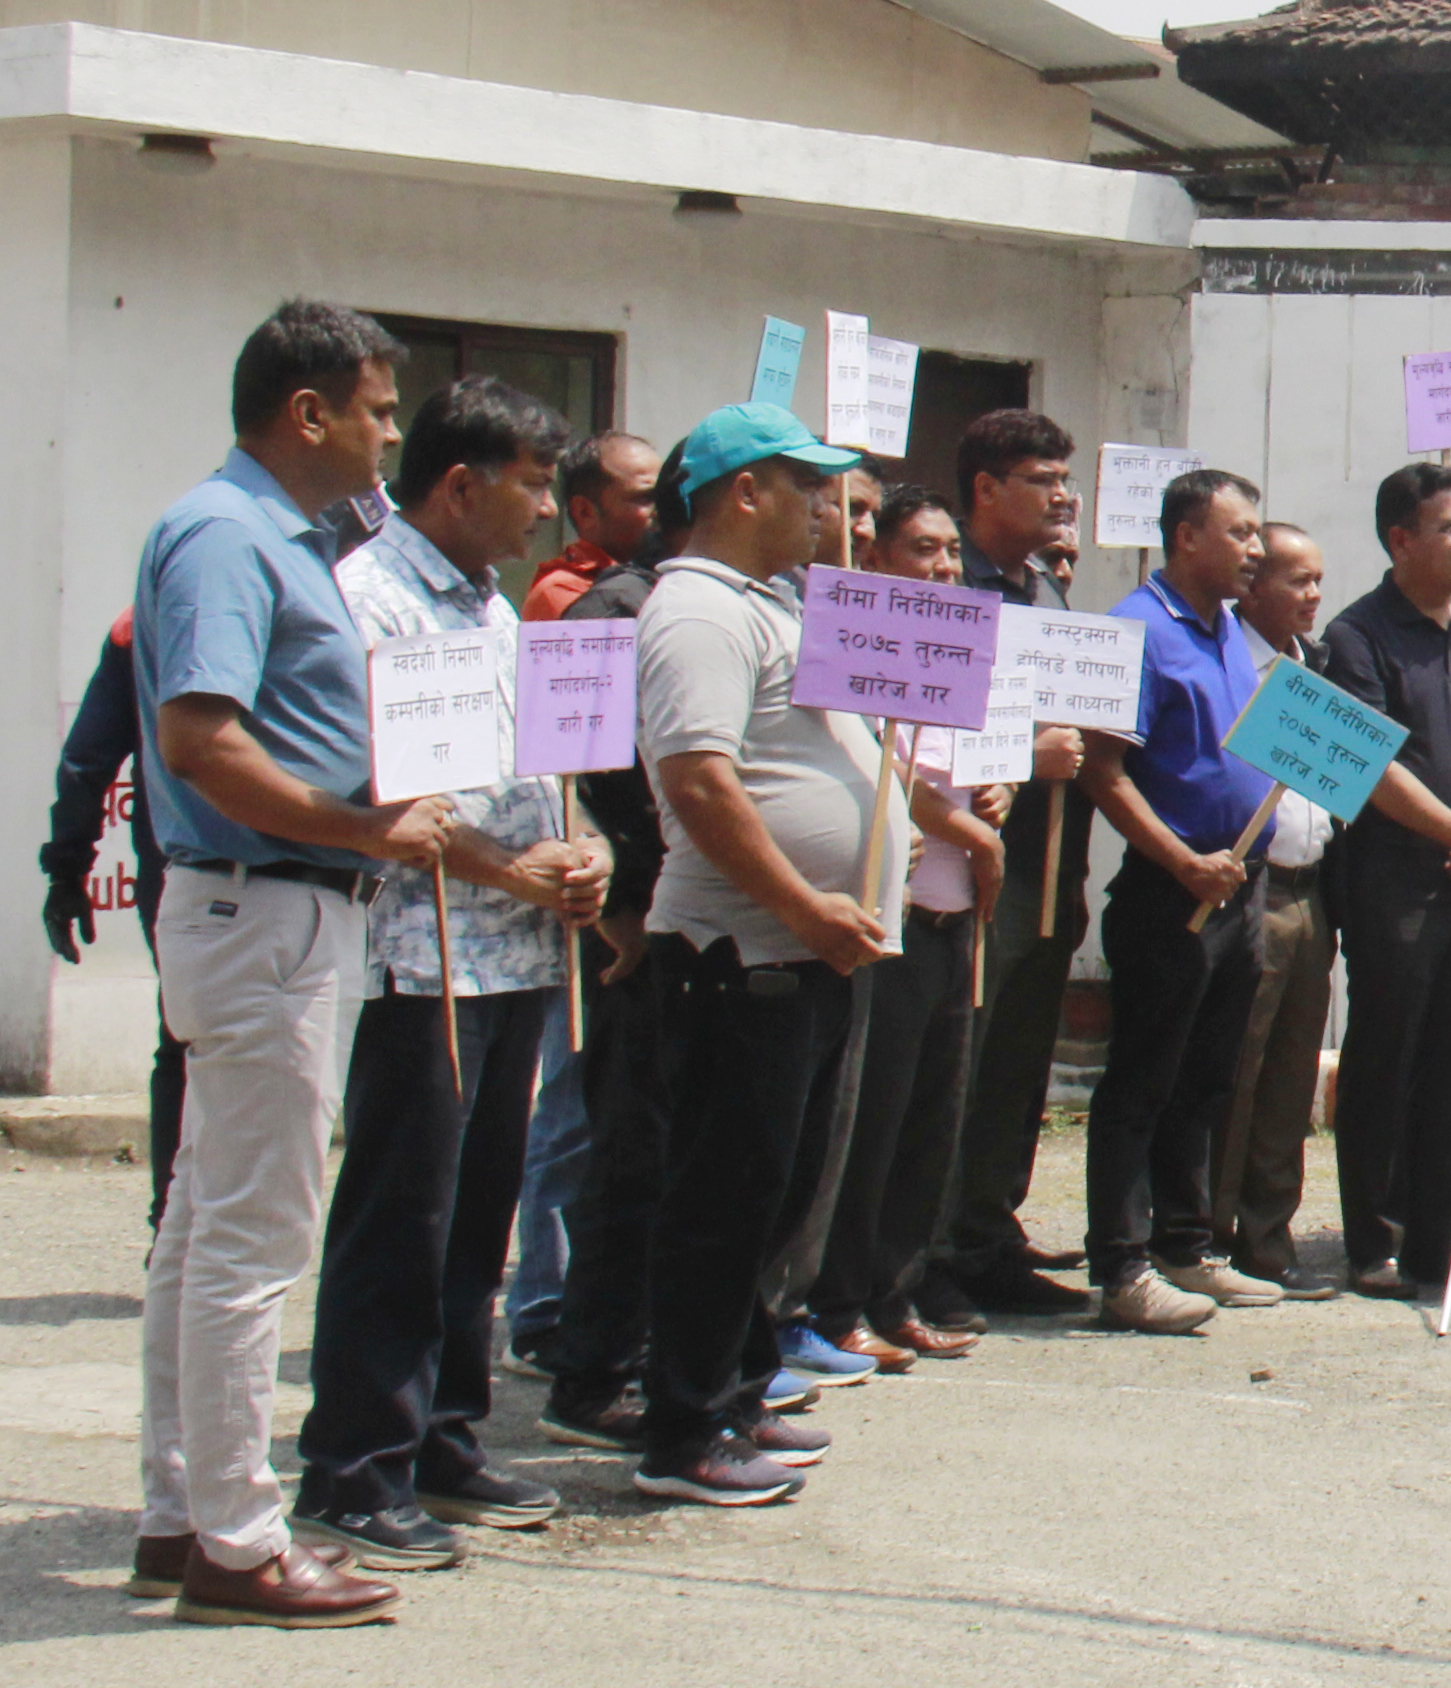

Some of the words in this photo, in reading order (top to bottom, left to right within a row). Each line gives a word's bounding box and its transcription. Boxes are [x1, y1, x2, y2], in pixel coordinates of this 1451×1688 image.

[1114, 454, 1150, 475] भुक्तानी
[1156, 459, 1171, 477] हुन
[1128, 483, 1154, 499] रहेको
[1107, 514, 1136, 532] तुरुन्त
[529, 632, 575, 664] मूल्यवृद्धि
[581, 632, 634, 652] समायोजन
[838, 629, 901, 656] २०७८
[915, 640, 974, 667] तुरुन्त
[1041, 622, 1120, 646] कन्स्ट्रक्सन
[392, 644, 436, 674] स्वदेशी
[442, 640, 484, 666] निर्माण
[1017, 650, 1066, 674] होलिडे
[1075, 656, 1130, 685] घोषणा,
[849, 671, 910, 700] खारेज
[921, 684, 951, 705] गर
[385, 690, 446, 723] कम्पनीको
[557, 711, 582, 733] जारी
[588, 714, 604, 732] गर
[432, 742, 451, 763] गर
[1278, 709, 1322, 746] २०७८
[1327, 740, 1370, 775] तुरुन्त
[1270, 745, 1312, 780] खारेज
[1318, 773, 1341, 796] गर
